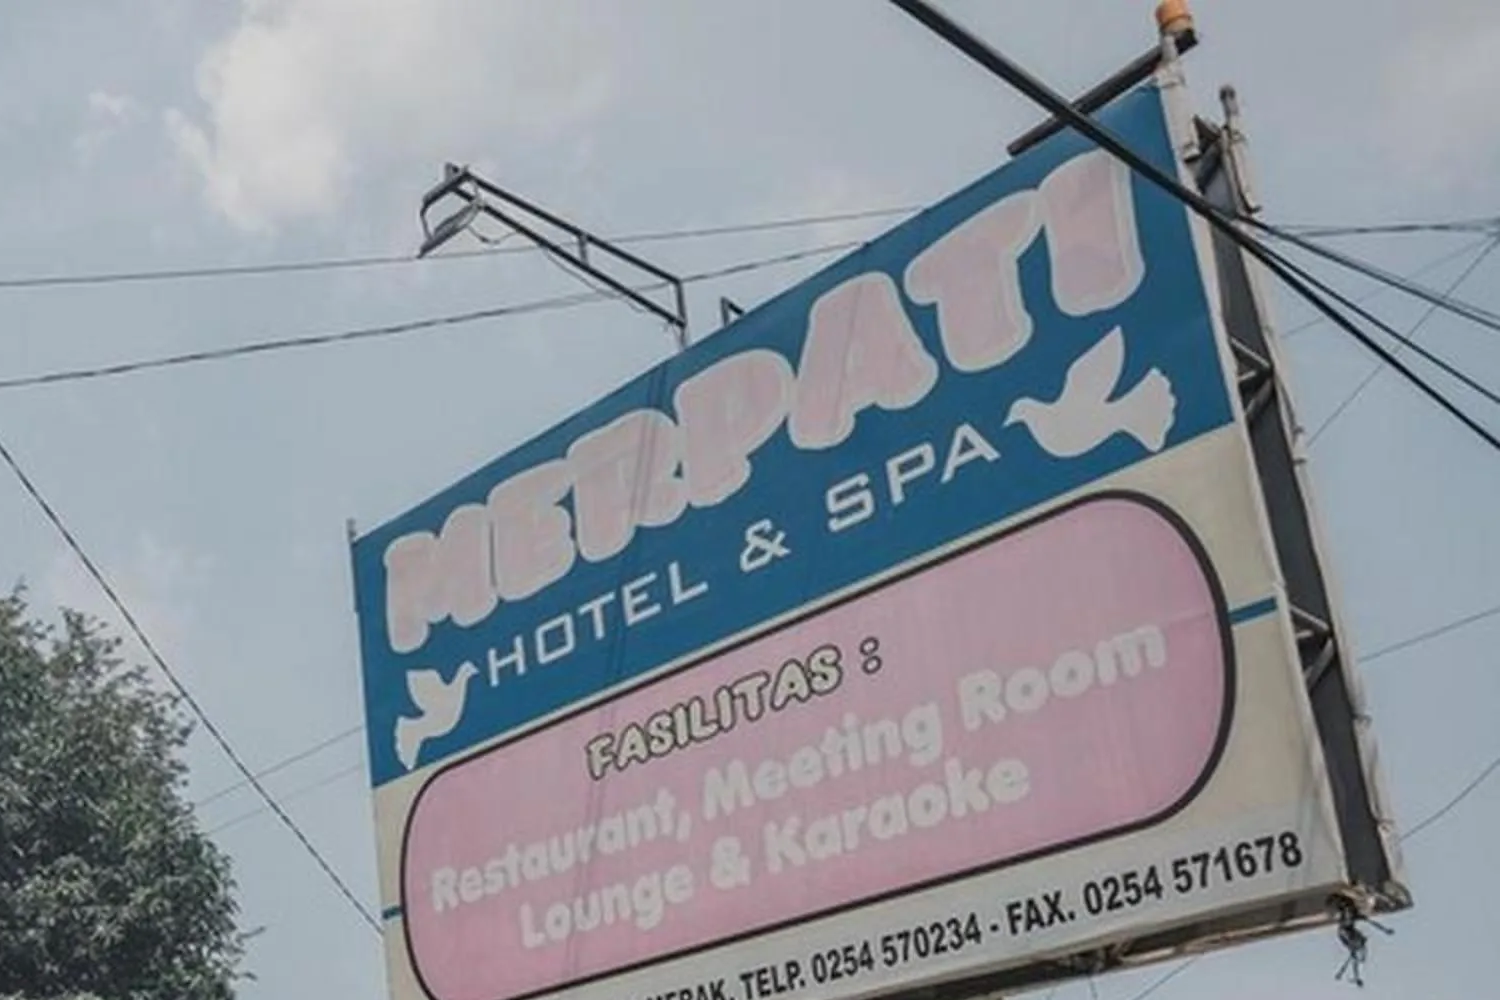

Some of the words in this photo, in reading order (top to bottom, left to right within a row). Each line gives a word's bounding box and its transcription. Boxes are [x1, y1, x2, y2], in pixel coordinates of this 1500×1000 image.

[382, 147, 1146, 654] MERPATI
[487, 558, 709, 689] HOTEL
[740, 518, 791, 572] &
[827, 422, 999, 533] SPA
[430, 785, 693, 913] Restaurant,
[702, 700, 943, 821] Meeting
[956, 622, 1168, 731] Room
[584, 643, 843, 781] FASILITAS
[517, 863, 695, 949] Lounge
[709, 835, 752, 891] &
[762, 756, 1031, 874] Karaoke
[812, 943, 875, 984] 0254
[881, 911, 982, 967] 570234
[1007, 889, 1077, 937] FAX.
[1083, 864, 1164, 916] 0254
[1172, 830, 1302, 895] 571678
